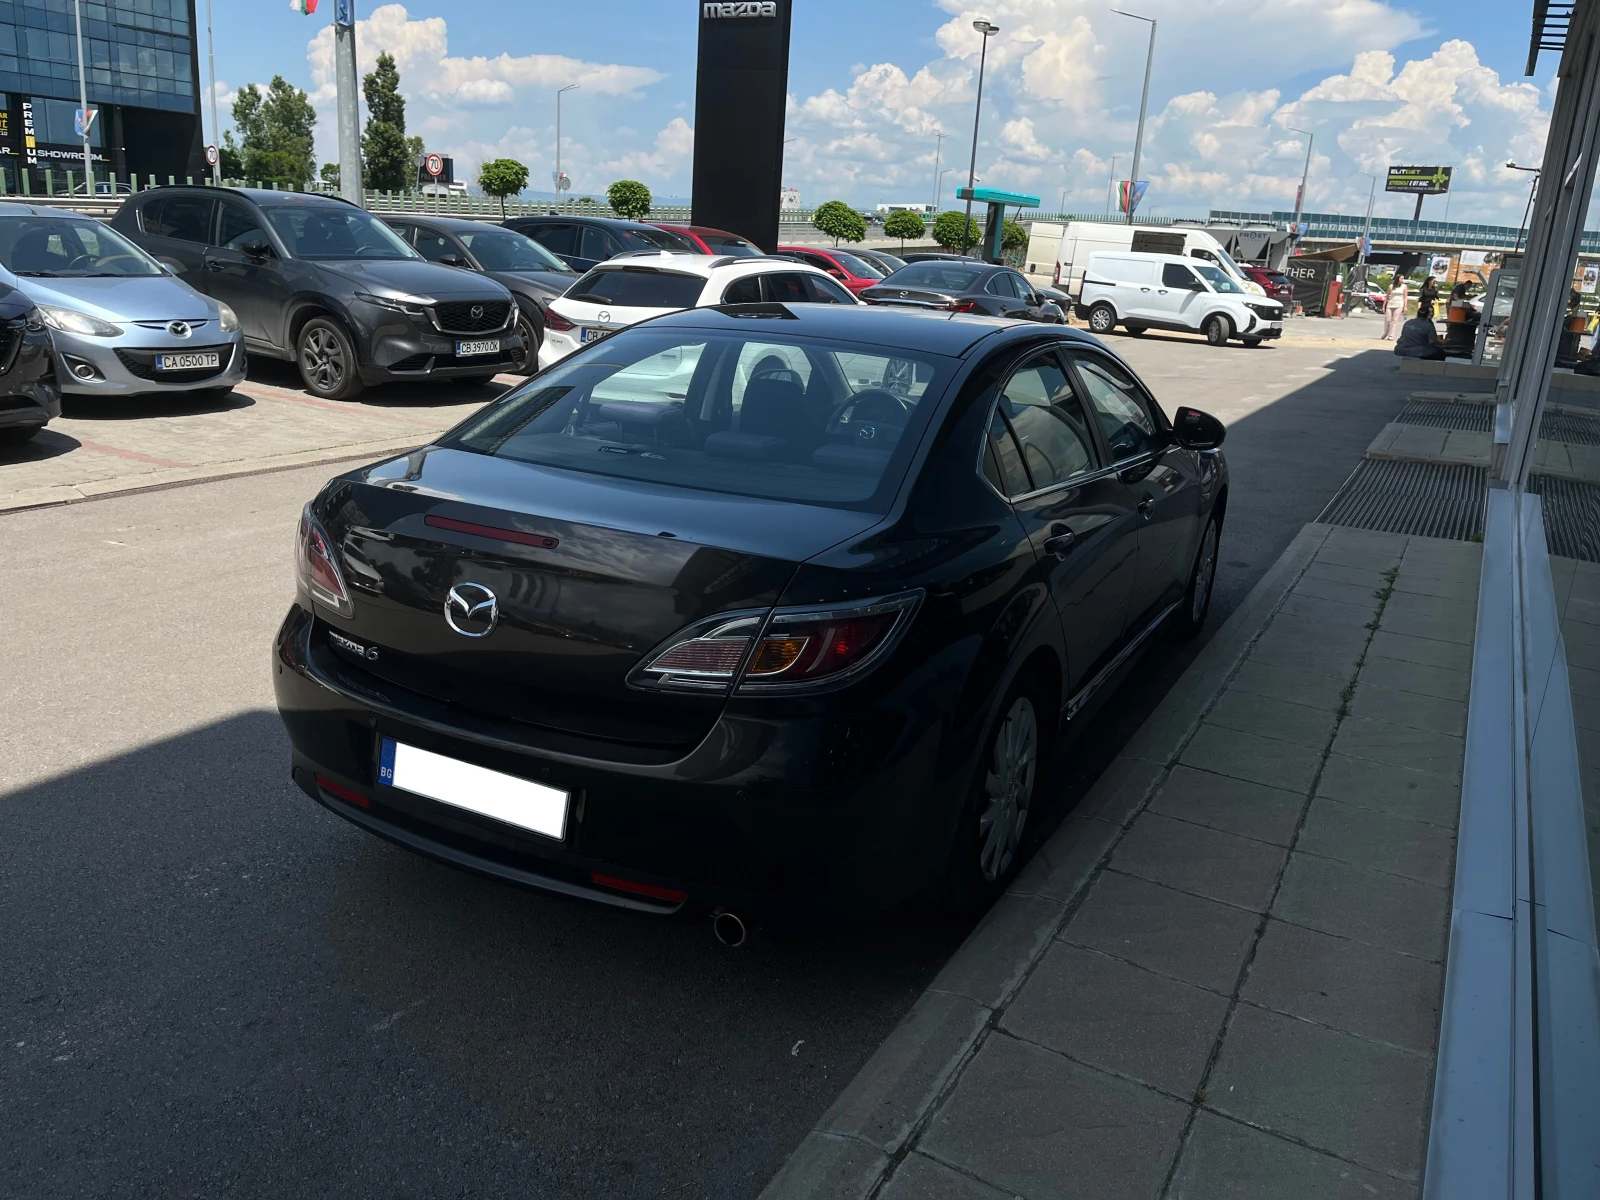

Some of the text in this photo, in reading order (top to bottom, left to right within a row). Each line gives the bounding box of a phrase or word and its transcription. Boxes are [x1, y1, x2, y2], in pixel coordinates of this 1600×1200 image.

[703, 2, 777, 19] mazda
[430, 158, 439, 170] 70
[1284, 267, 1316, 279] THER
[461, 343, 472, 354] CB
[472, 342, 489, 353] 3970
[164, 357, 178, 367] CA
[180, 355, 203, 367] 0500
[205, 354, 217, 365] TP
[380, 765, 393, 779] BG
